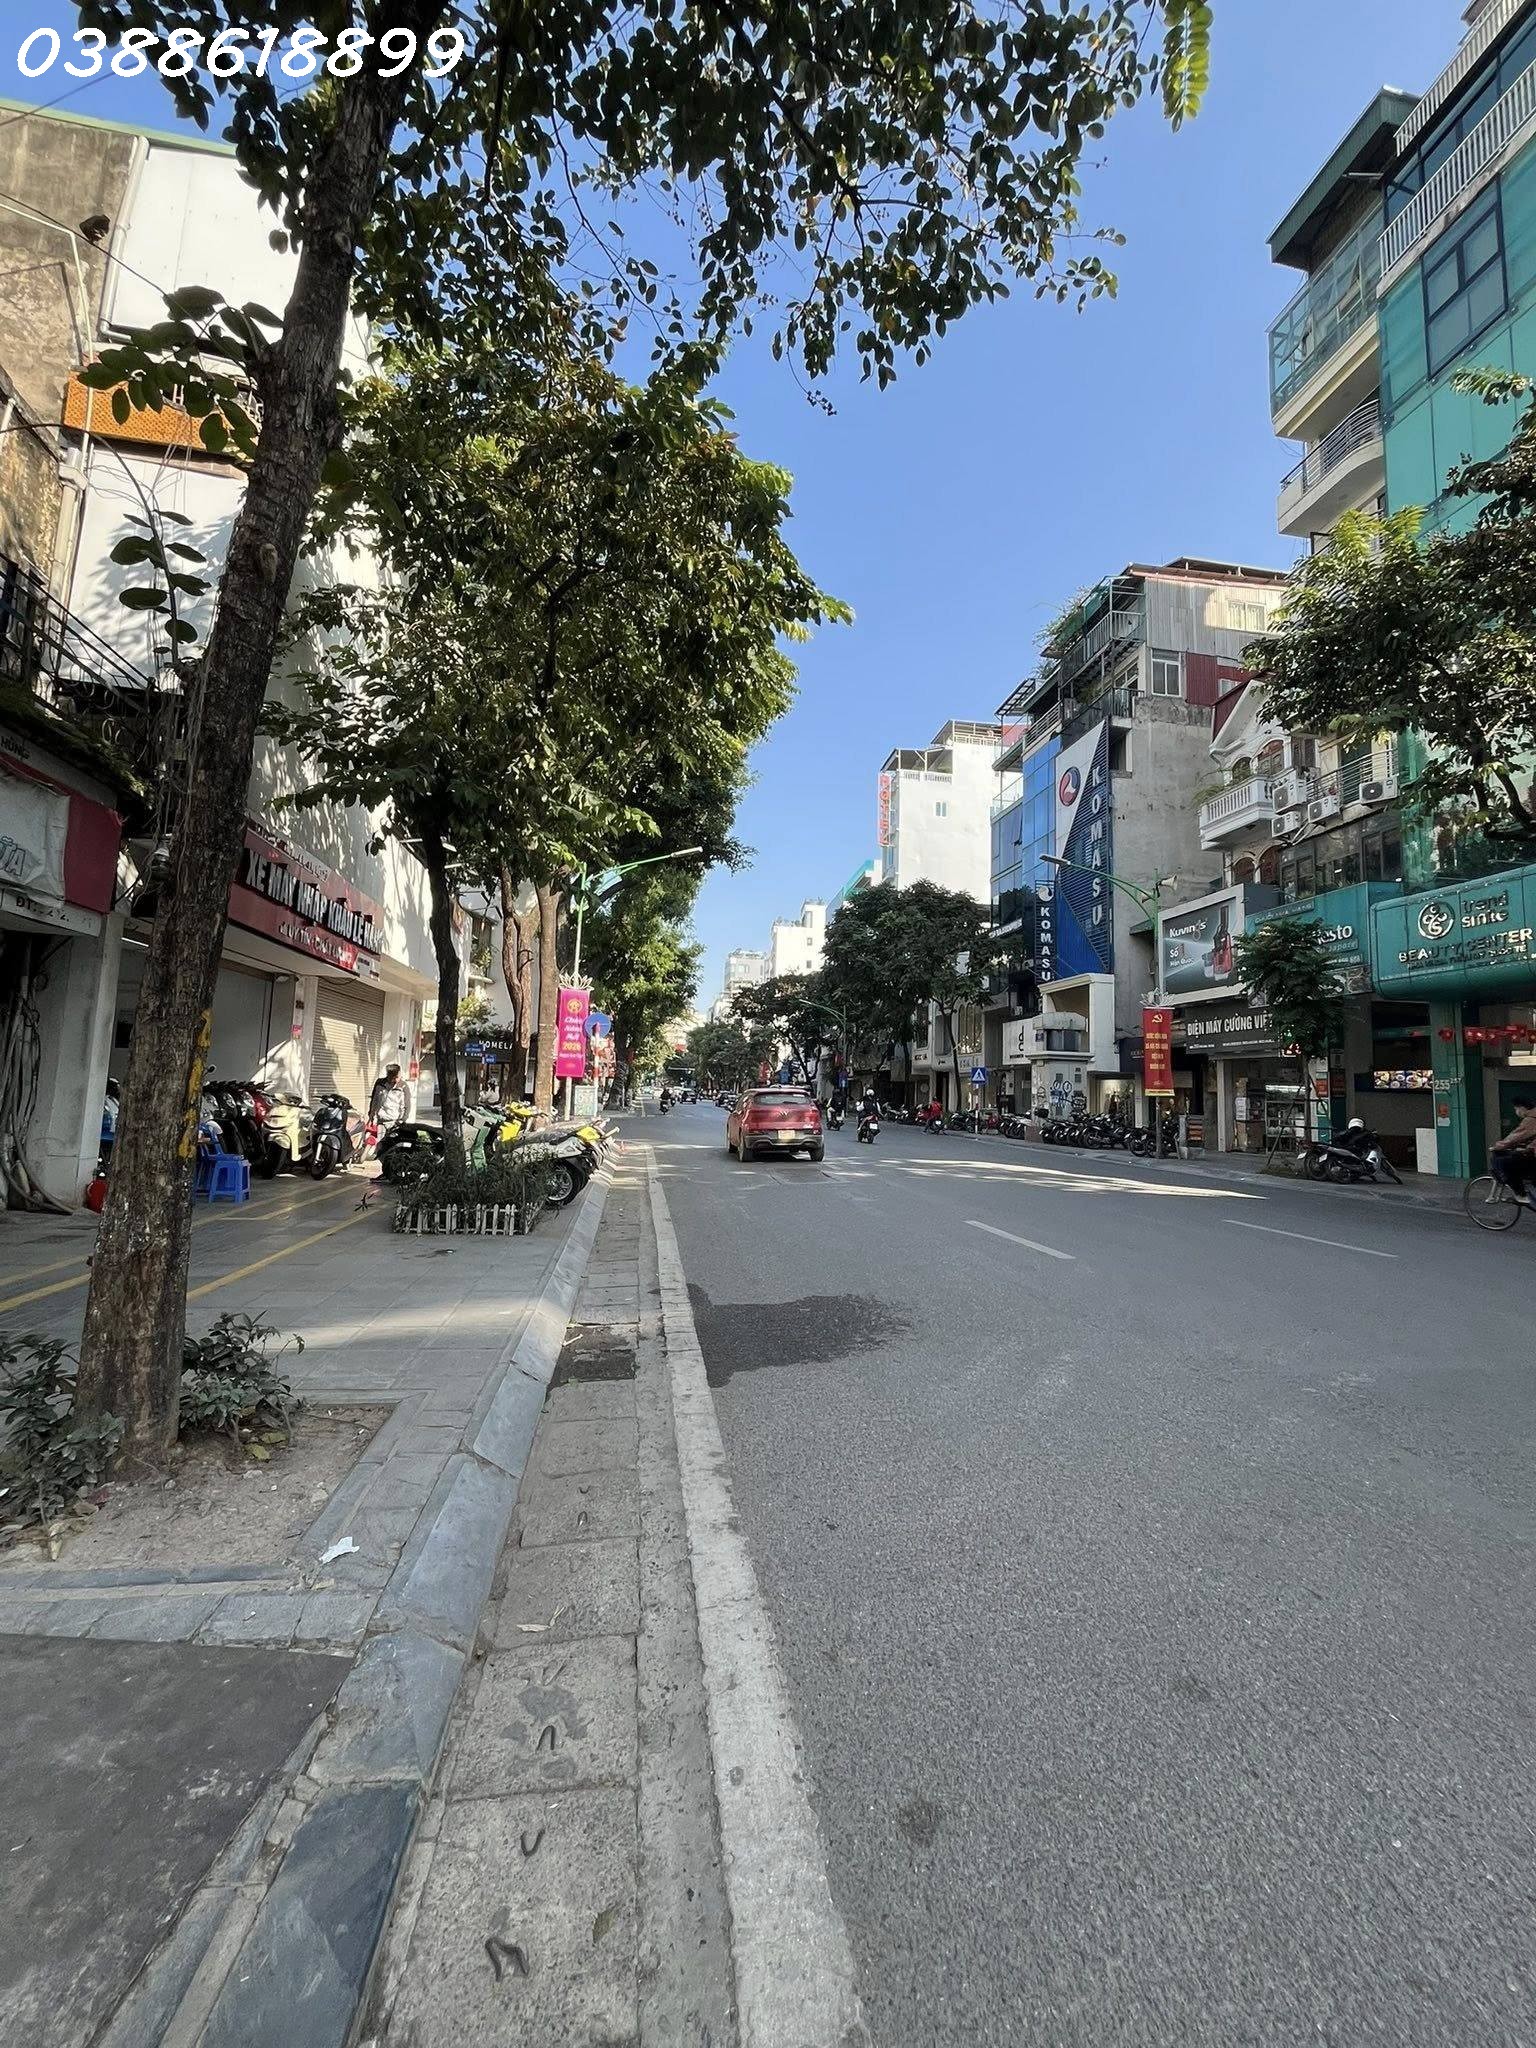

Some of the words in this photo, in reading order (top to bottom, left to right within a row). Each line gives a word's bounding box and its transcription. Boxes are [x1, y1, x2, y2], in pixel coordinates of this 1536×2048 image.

[246, 850, 267, 892] XE
[1091, 766, 1103, 926] KOMASU
[1040, 907, 1051, 981] KOMASU
[1187, 1019, 1205, 1039] ĐIỆN
[1206, 1016, 1222, 1035] MÁY
[1224, 1012, 1253, 1033] CƯỜNG
